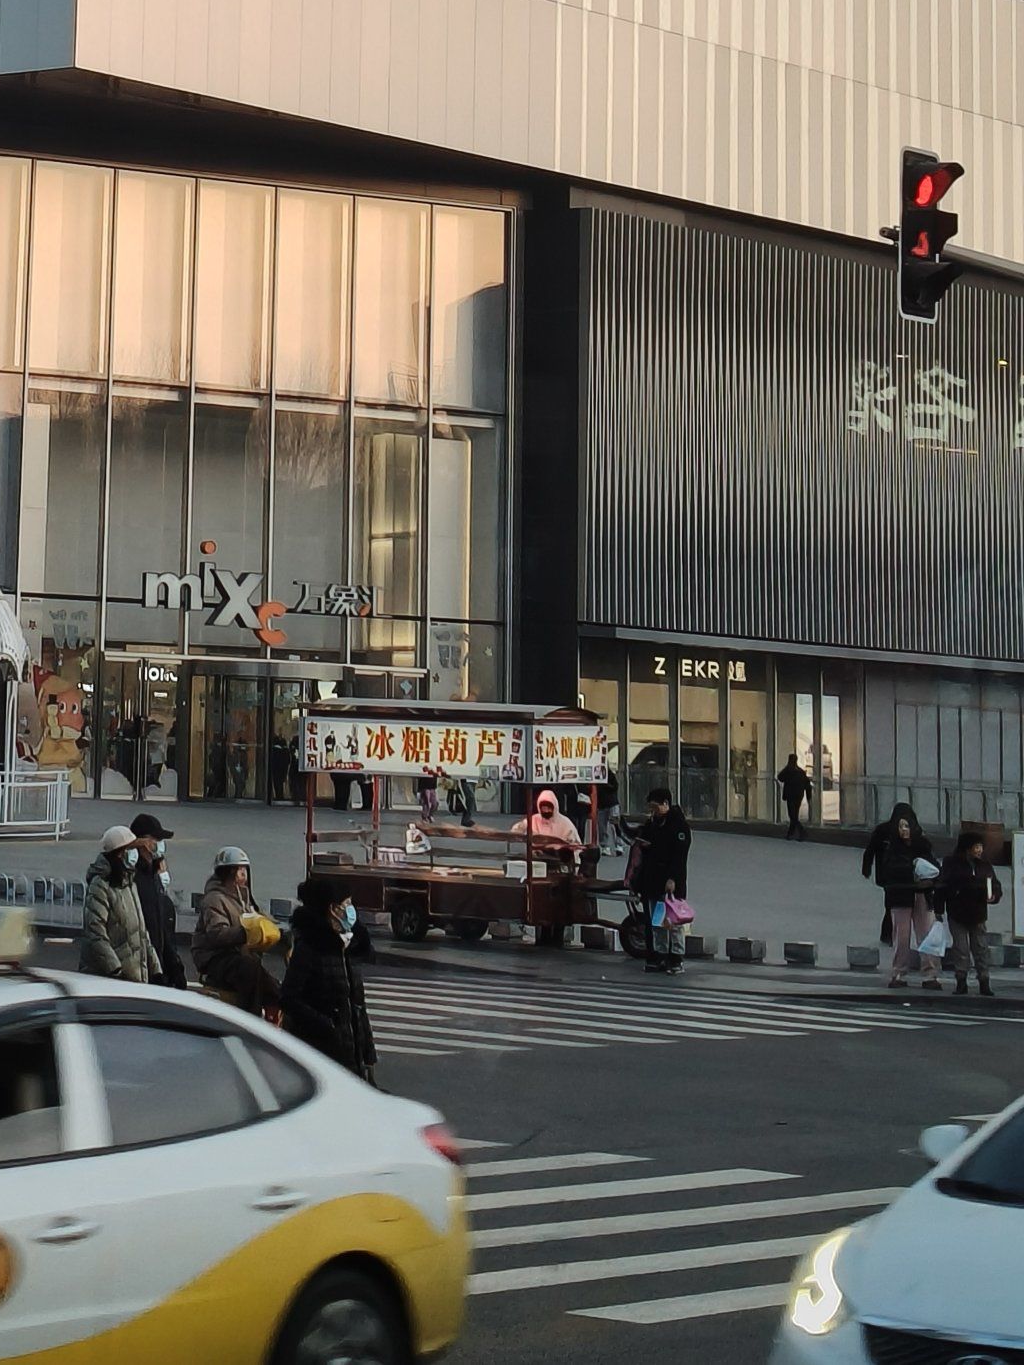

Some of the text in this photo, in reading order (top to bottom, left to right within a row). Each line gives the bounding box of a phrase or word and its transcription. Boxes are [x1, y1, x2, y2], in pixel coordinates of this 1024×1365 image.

[654, 656, 720, 679] ZEKR
[365, 724, 506, 767] 冰糖葫芦
